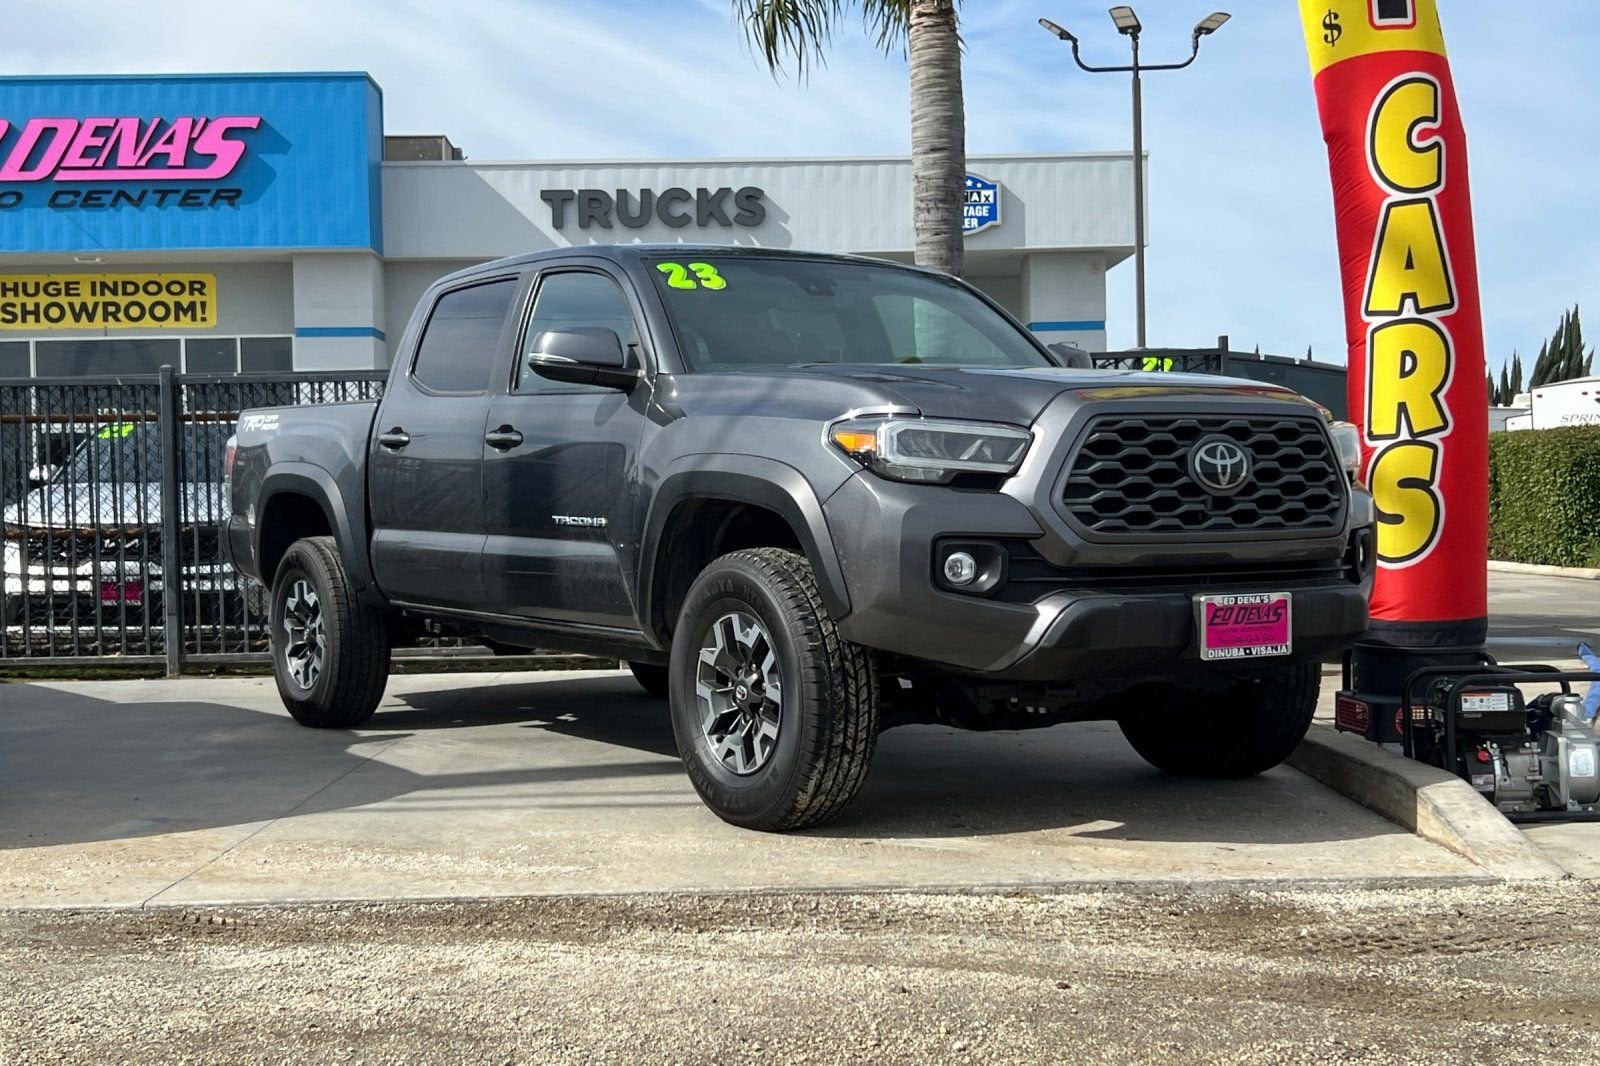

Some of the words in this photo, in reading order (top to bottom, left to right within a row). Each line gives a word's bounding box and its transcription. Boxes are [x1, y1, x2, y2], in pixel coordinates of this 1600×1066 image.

[0, 117, 261, 181] DENA'S
[47, 188, 243, 209] CENTER
[965, 190, 991, 203] AX
[540, 187, 766, 229] TRUCKS
[656, 262, 727, 290] 23
[1, 280, 81, 298] HUGE
[90, 279, 208, 297] INDOOR
[1, 300, 208, 324] SHOWROOM!
[1365, 71, 1456, 570] CARS
[551, 515, 608, 527] TACOMA
[1223, 597, 1235, 605] ED
[1237, 595, 1269, 605] DENA'S
[1208, 647, 1245, 659] DINUBA
